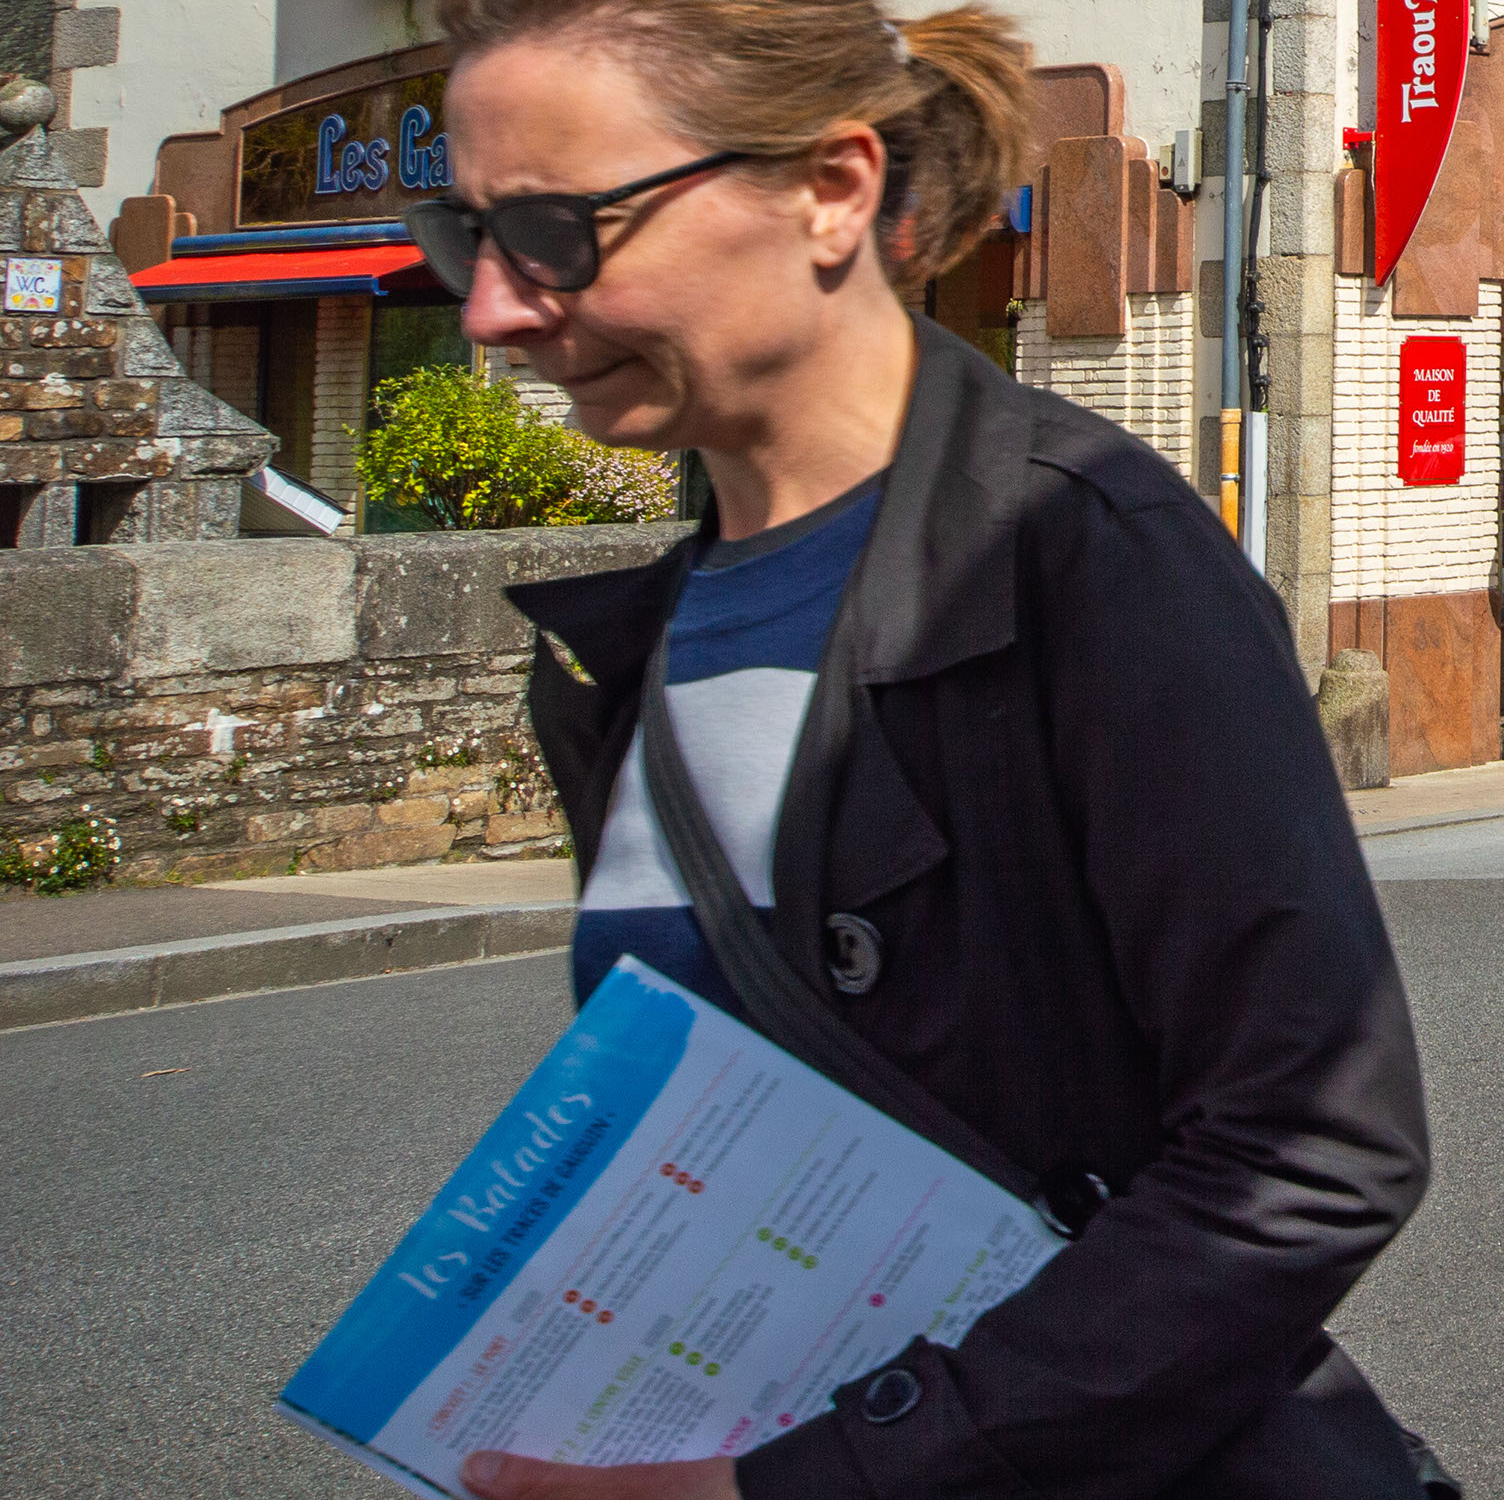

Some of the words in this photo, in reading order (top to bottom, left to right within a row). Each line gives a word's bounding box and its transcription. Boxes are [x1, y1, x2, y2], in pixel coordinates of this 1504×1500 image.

[315, 113, 390, 194] Les
[16, 275, 49, 294] W.C.
[1413, 368, 1454, 381] MAISON
[1428, 389, 1441, 402] DE
[1412, 407, 1455, 427] QUALITÉ
[1410, 440, 1432, 458] fondée
[1432, 444, 1440, 453] en
[1440, 443, 1454, 454] 1920
[449, 1088, 593, 1235] Balades
[501, 1193, 550, 1249] TRACES
[554, 1114, 612, 1181] GAUGUIN
